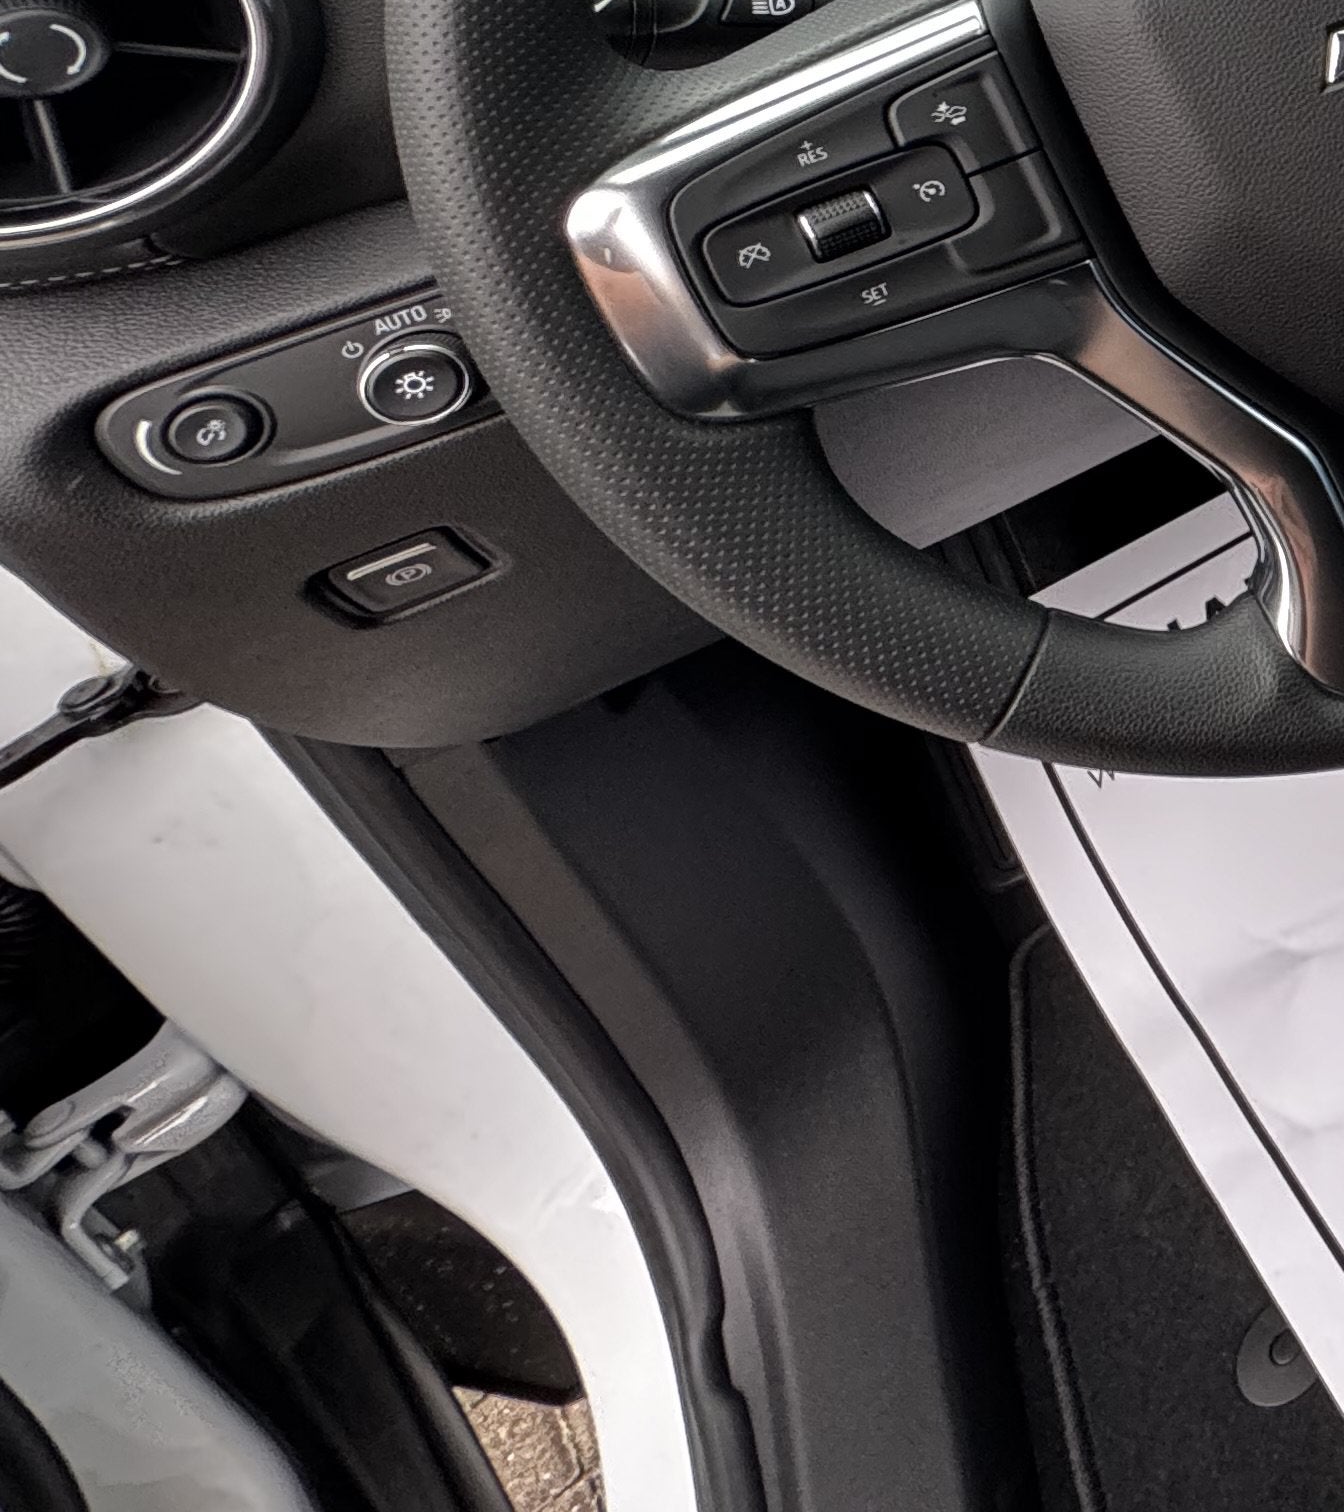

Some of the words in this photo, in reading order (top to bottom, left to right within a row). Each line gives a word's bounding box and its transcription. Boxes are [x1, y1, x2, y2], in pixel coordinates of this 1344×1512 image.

[797, 145, 829, 168] RES
[860, 282, 889, 304] SET
[374, 304, 427, 336] AUTO
